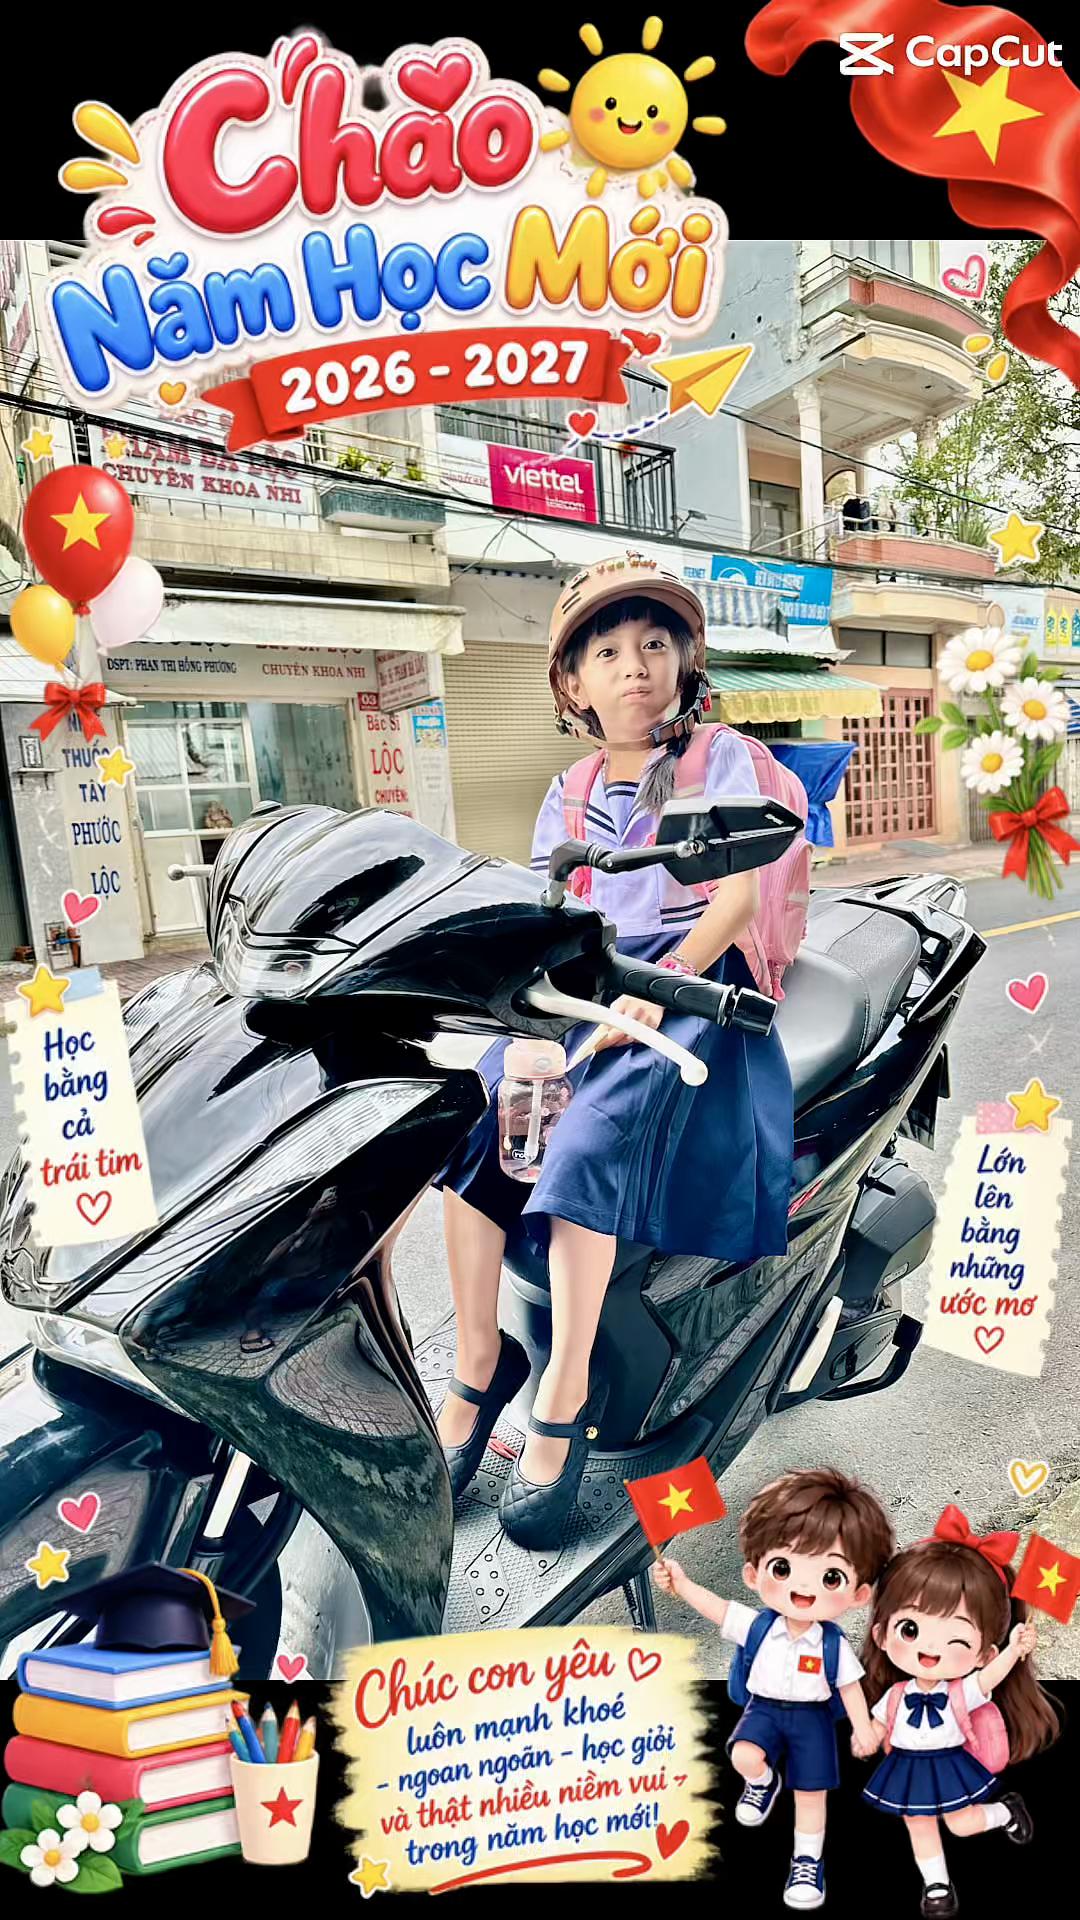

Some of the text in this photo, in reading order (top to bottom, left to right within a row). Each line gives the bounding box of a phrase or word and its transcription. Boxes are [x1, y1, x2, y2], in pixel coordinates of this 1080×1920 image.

[102, 462, 302, 504] CHUYÊN KHOA NHI
[503, 463, 584, 494] viettel
[312, 665, 344, 678] KHOA
[346, 667, 366, 679] NHI
[361, 694, 377, 705] 03
[370, 741, 404, 781] LỘC
[79, 780, 107, 803] TÂY
[71, 816, 121, 846] PHƯỚC
[91, 865, 120, 899] LỘC
